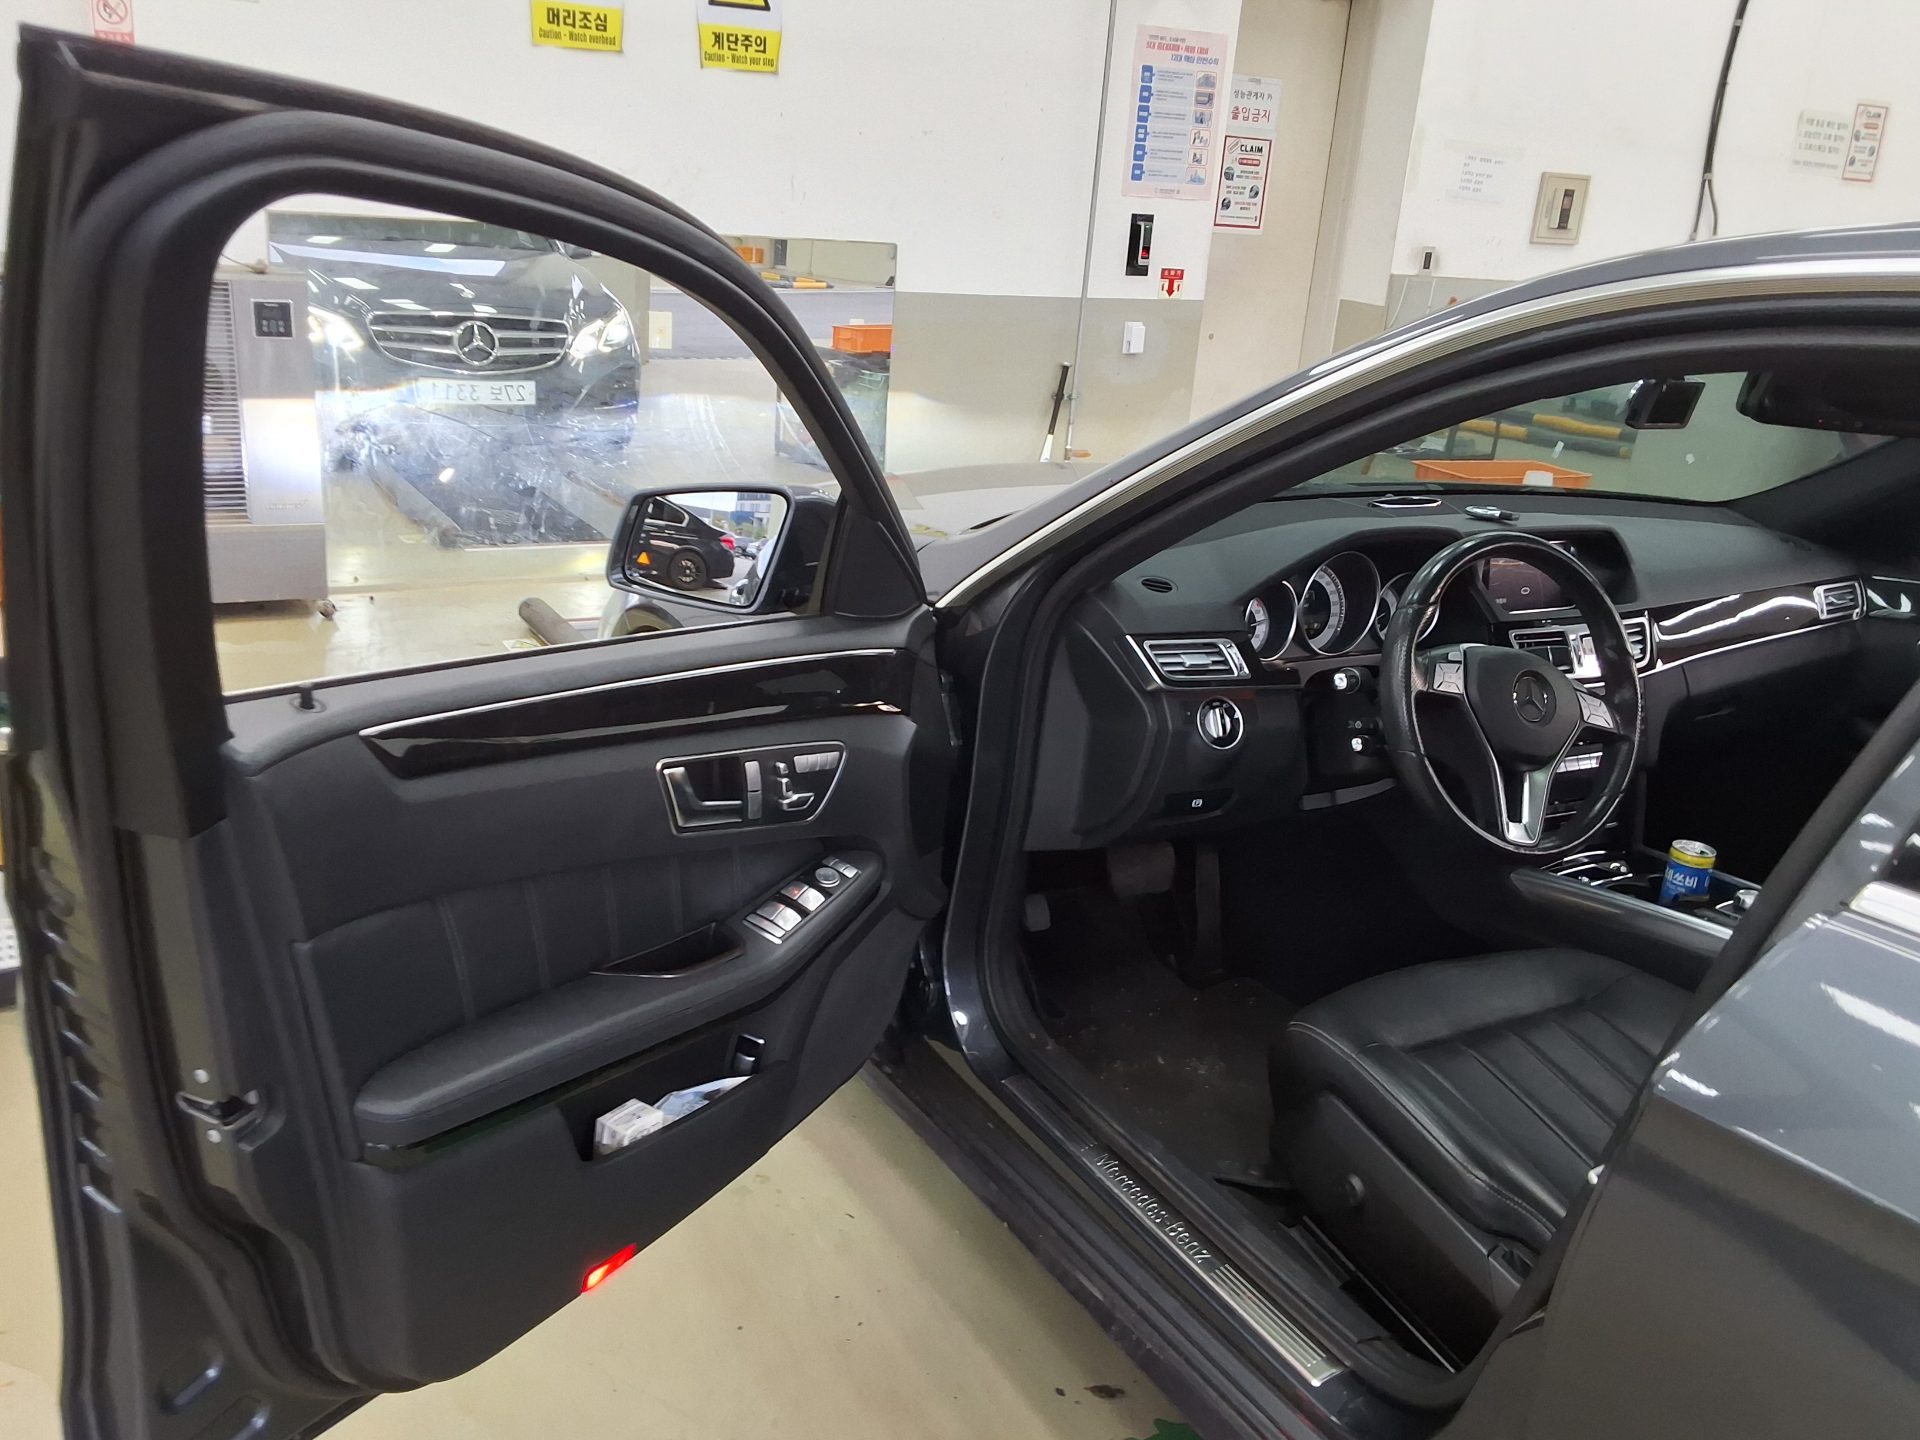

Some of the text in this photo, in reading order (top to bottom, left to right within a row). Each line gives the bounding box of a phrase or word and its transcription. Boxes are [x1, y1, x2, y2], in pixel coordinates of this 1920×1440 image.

[546, 7, 608, 33] 머리조심
[538, 27, 562, 40] Caution
[568, 30, 588, 43] Watch
[589, 34, 616, 46] overhead
[711, 31, 767, 54] 계단주의
[704, 50, 726, 63] Caution
[731, 53, 748, 65] Watch
[749, 56, 762, 67] your
[762, 56, 775, 68] step
[1231, 106, 1271, 123] 출입금지
[1239, 144, 1263, 154] CLAIM
[1094, 1153, 1212, 1264] Mercedes-Benz
